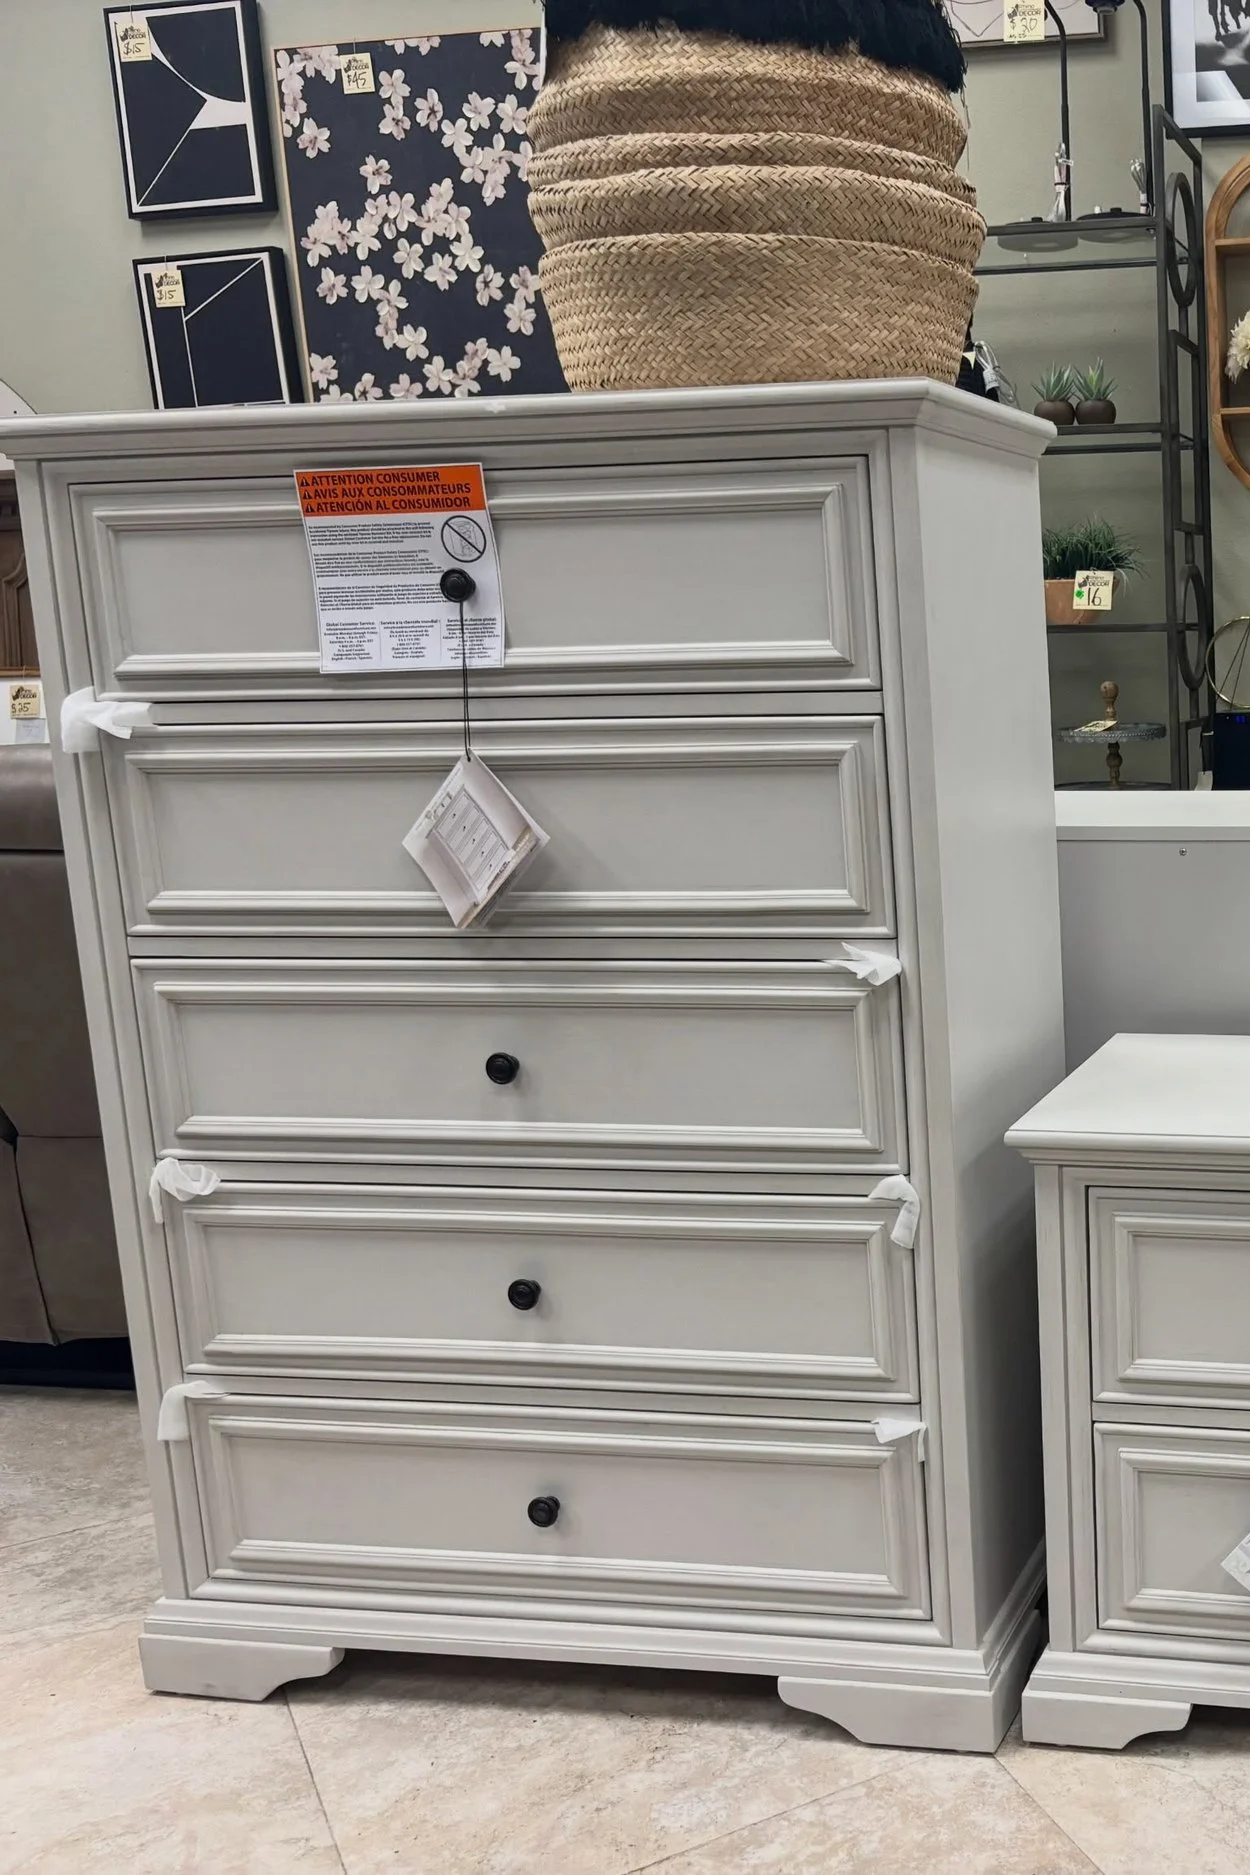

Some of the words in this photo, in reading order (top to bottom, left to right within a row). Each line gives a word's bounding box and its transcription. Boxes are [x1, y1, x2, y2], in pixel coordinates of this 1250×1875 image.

[123, 41, 145, 56] $15
[311, 473, 374, 487] ATTENTION
[376, 471, 440, 485] CONSUMER
[313, 488, 339, 499] AVIS
[341, 487, 365, 499] AUX
[367, 483, 471, 498] CONSOMMATEURS
[316, 498, 374, 513] ATENCIÓN
[375, 500, 390, 511] AL
[391, 496, 471, 510] CONSUMIDOR
